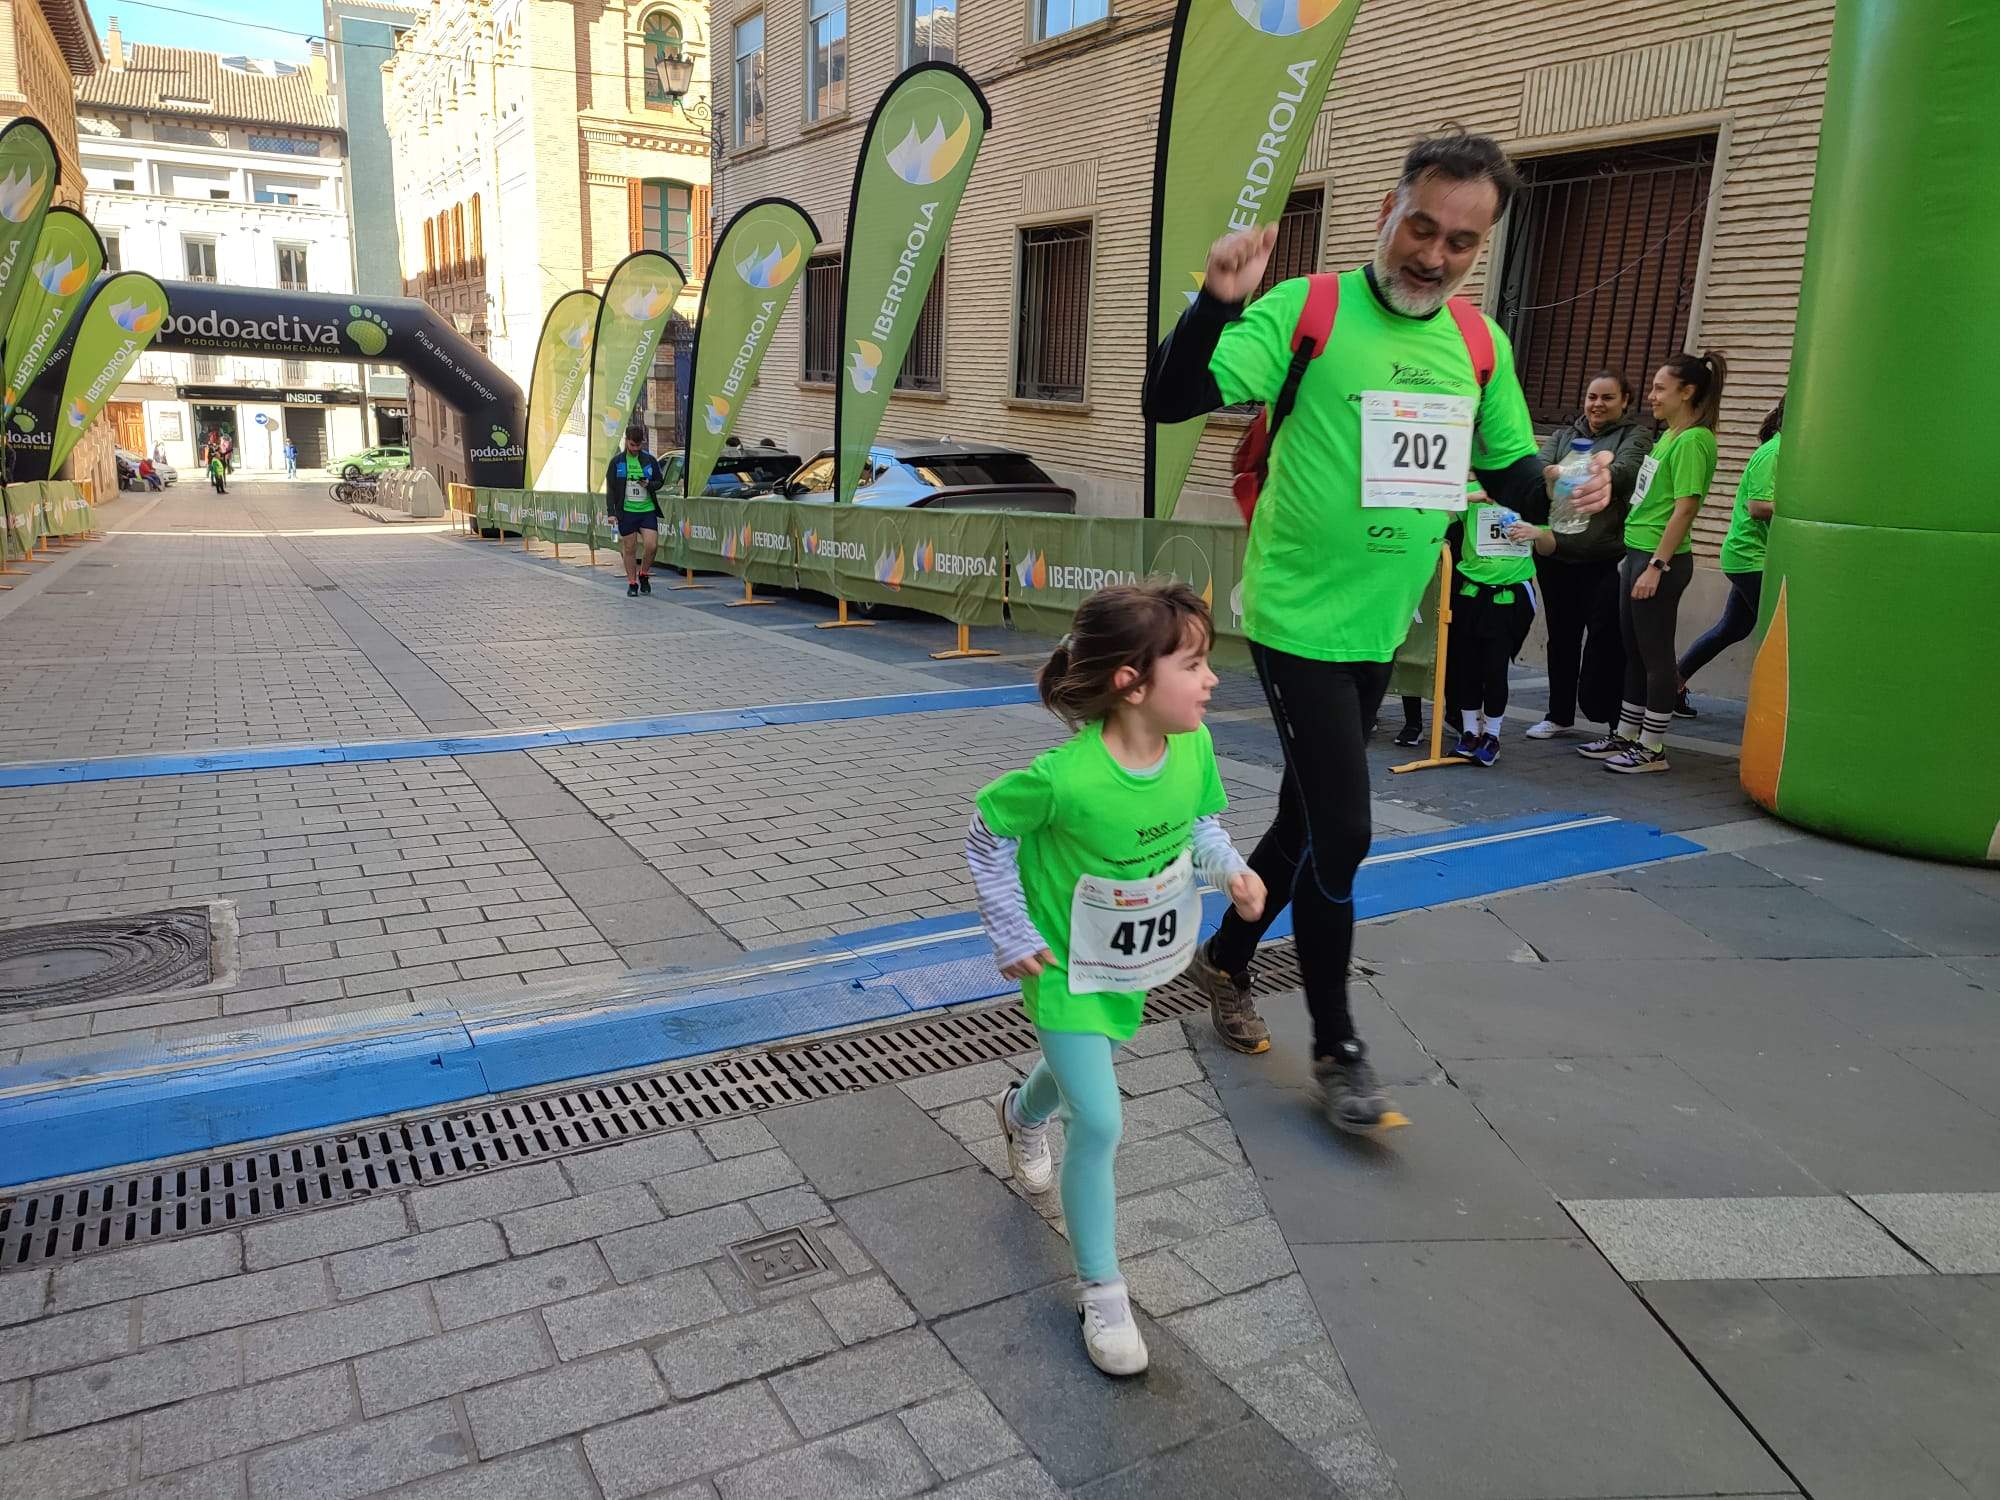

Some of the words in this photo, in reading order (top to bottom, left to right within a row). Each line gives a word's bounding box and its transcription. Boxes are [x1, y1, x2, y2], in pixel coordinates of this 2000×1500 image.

[1227, 58, 1318, 231] ERDROLA
[872, 202, 939, 341] IBERDROLA
[156, 310, 340, 345] podoactiva
[184, 337, 249, 349] PODOLOGÍA
[264, 343, 340, 354] BIOMECÁNICA
[721, 300, 777, 397] IBERDROLA
[84, 339, 137, 403] IBERDROLA
[414, 330, 434, 350] Pisa
[433, 347, 453, 369] bien,
[455, 365, 472, 382] vive
[471, 380, 498, 402] mejor
[614, 328, 655, 407] IBERDROLA
[286, 393, 323, 403] INSIDE
[1392, 431, 1448, 470] 202
[935, 552, 998, 577] IBERDROLA
[1110, 909, 1177, 956] 479
